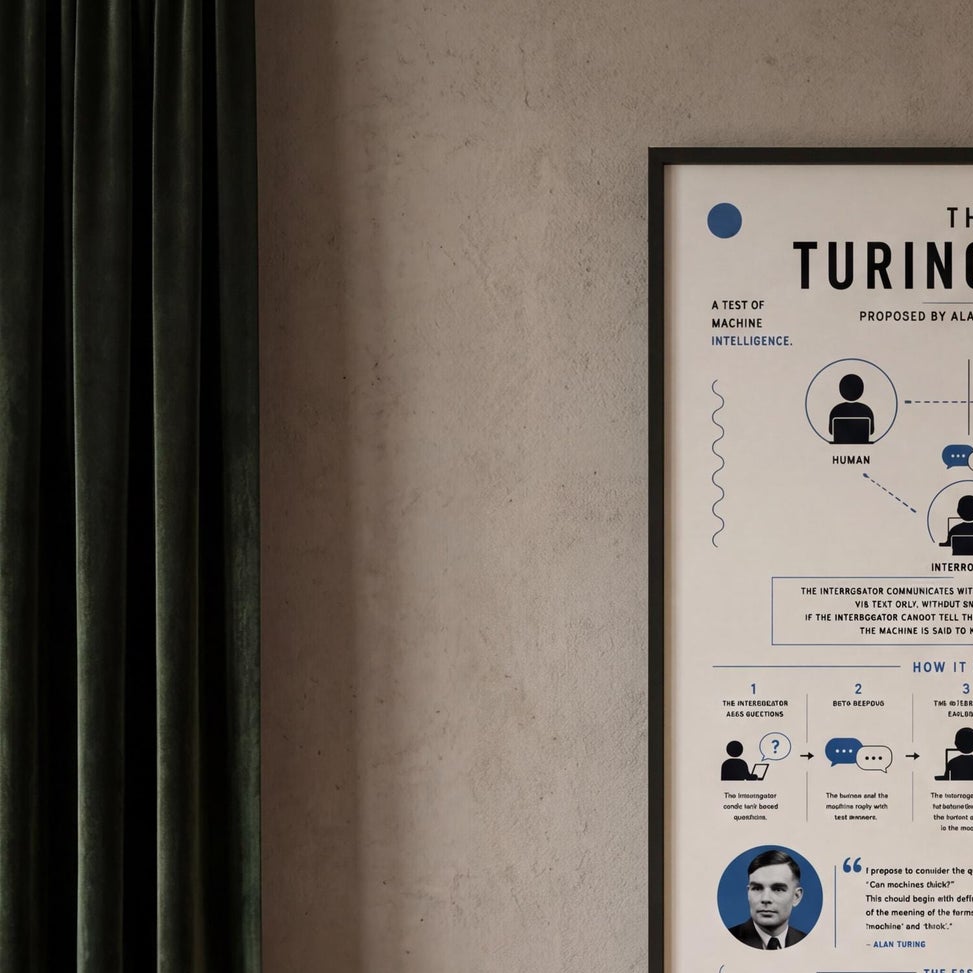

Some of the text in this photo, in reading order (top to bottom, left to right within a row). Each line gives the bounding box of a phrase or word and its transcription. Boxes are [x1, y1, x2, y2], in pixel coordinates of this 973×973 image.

[711, 299, 765, 310] A TEST OF
[859, 310, 926, 322] PROPOSED
[930, 310, 946, 322] BY
[711, 317, 763, 329] MACHINE
[711, 335, 793, 347] INTELLIGENCE.
[832, 455, 871, 465] HUMAN
[800, 587, 817, 596] THE
[886, 587, 955, 596] COMMUNICATES
[871, 600, 893, 609] TEXT
[805, 613, 813, 621] IF
[815, 613, 832, 622] THE
[938, 613, 959, 622] TELL
[859, 626, 876, 635] THE
[879, 626, 918, 635] MACHINE
[921, 626, 930, 635] IS
[932, 626, 953, 635] SAID
[955, 626, 967, 635] TO
[912, 661, 946, 673] HOW
[953, 661, 967, 673] IT
[750, 682, 756, 695] 1
[854, 683, 862, 695] 2
[962, 682, 970, 695] 3
[722, 699, 736, 707] THE
[904, 867, 914, 875] to
[951, 866, 966, 875] the
[865, 894, 882, 903] This
[865, 908, 875, 917] of
[875, 908, 890, 917] the
[927, 908, 936, 917] of
[937, 908, 951, 917] the
[872, 940, 926, 948] ALAN TURING
